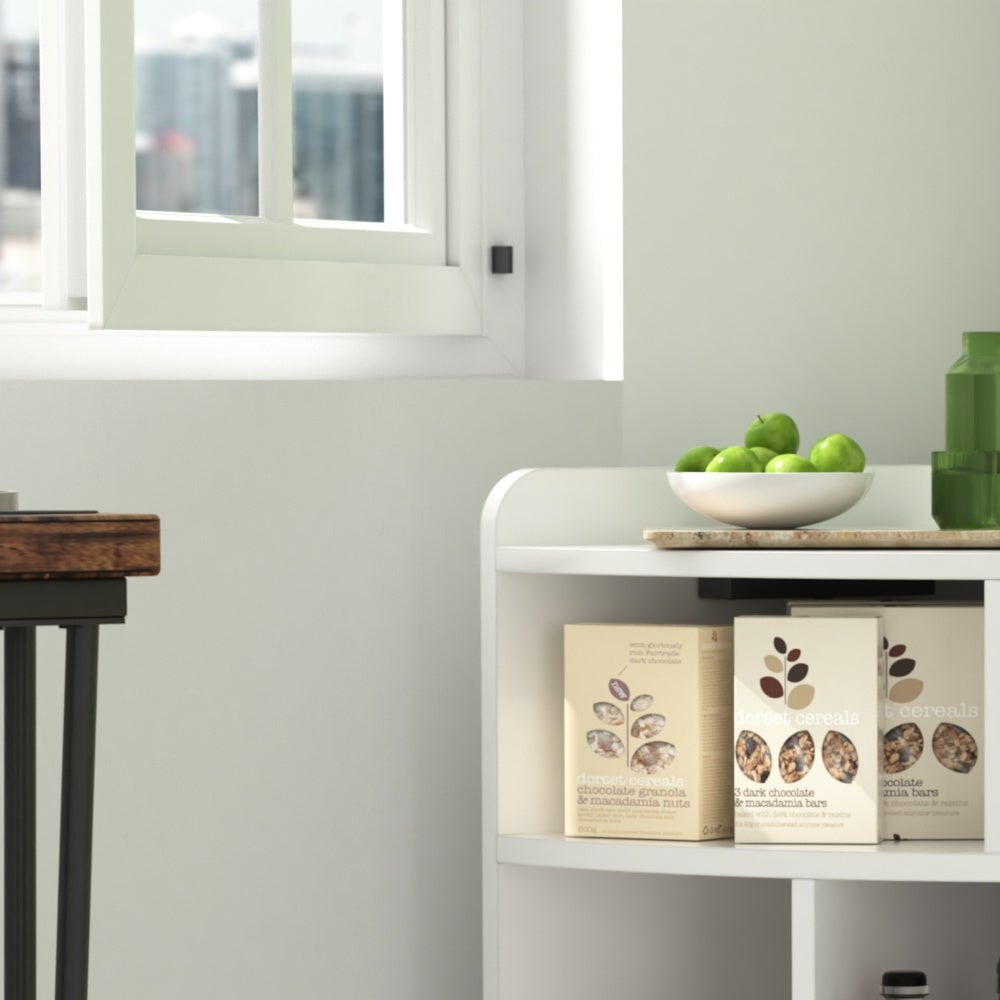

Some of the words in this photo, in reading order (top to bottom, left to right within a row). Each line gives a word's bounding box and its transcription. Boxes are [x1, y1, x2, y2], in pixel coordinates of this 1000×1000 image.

[900, 702, 979, 718] cereals
[736, 709, 791, 726] dorset
[795, 709, 860, 726] cereals
[577, 785, 636, 796] chocolate
[638, 787, 687, 798] granola
[743, 788, 766, 797] dark
[768, 788, 815, 797] chocolate
[912, 788, 939, 797] bars
[590, 797, 660, 807] macadamia
[663, 799, 691, 808] nuts
[745, 799, 803, 808] macadamia
[806, 799, 827, 808] bars
